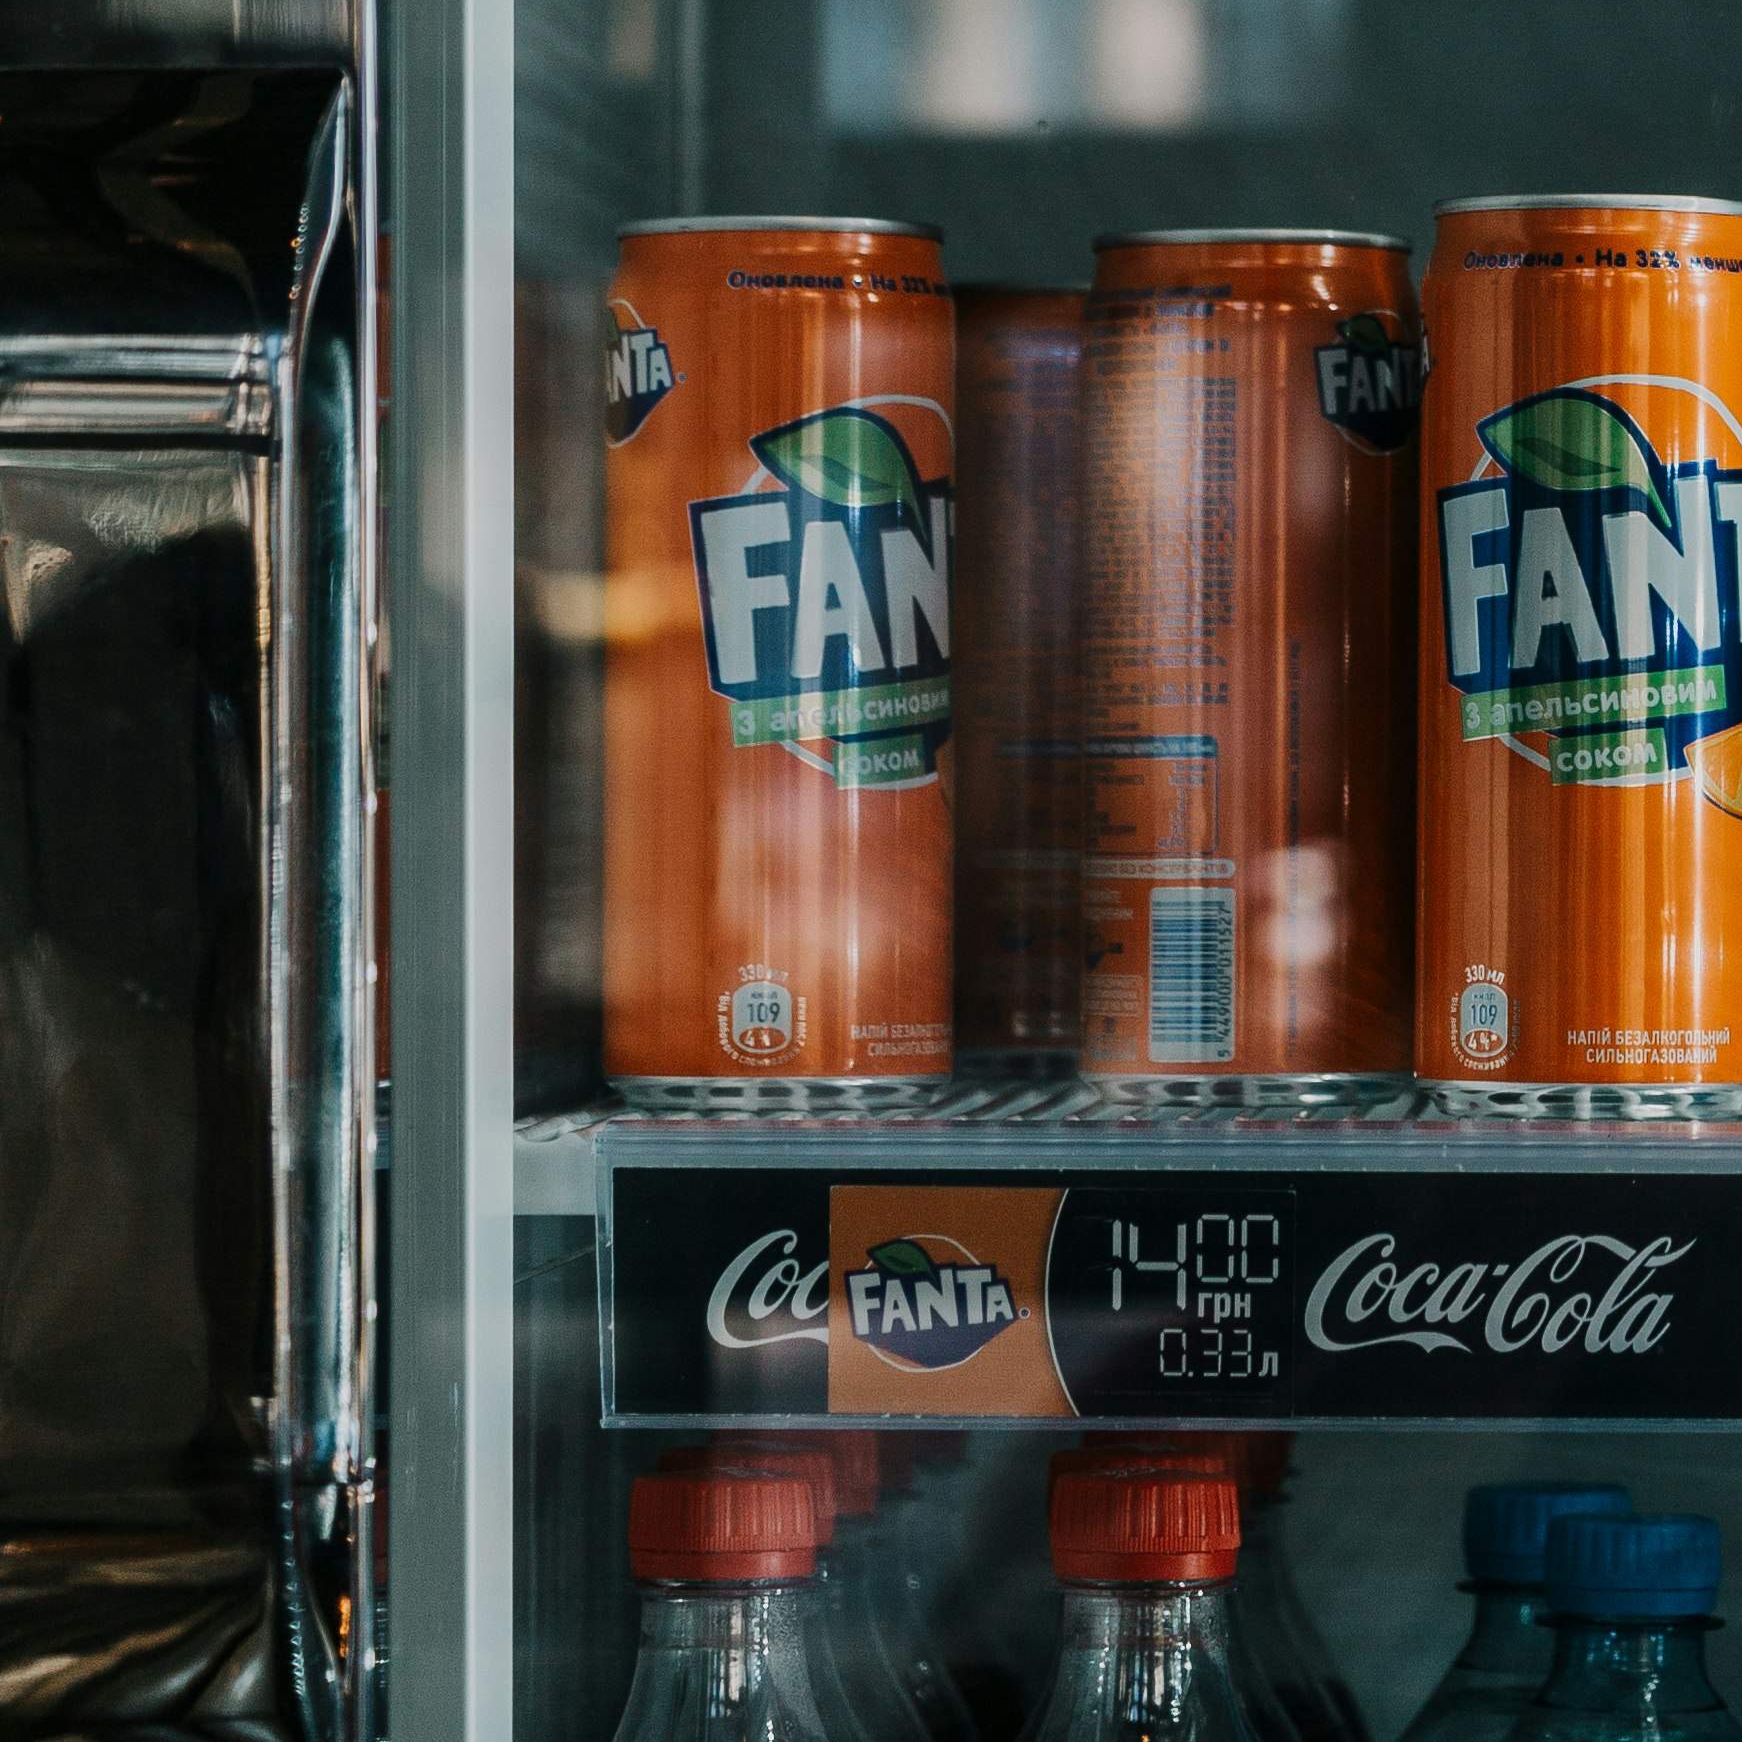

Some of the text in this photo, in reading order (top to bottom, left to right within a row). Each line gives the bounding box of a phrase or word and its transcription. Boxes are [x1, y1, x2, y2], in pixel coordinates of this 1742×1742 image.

[1462, 249, 1565, 271] Оновлена
[1594, 248, 1628, 269] На
[1634, 248, 1681, 271] 32%
[726, 269, 845, 290] Оновлена
[1488, 678, 1718, 724] апельсиновим
[840, 747, 919, 778] соком
[1555, 743, 1658, 774] соком
[1464, 963, 1506, 985] 330 мл
[747, 1002, 782, 1024] 109
[1470, 1003, 1498, 1026] 109
[1566, 1026, 1731, 1046] НАПІЙ БЕЗАЛКОГОЛЬНИЙ
[1585, 1046, 1718, 1065] СИЛЬНОГАЗОВАНИЙ
[848, 1267, 1015, 1337] FANTA
[1304, 1232, 1698, 1354] Coca-Cola
[1197, 1292, 1251, 1324] грн
